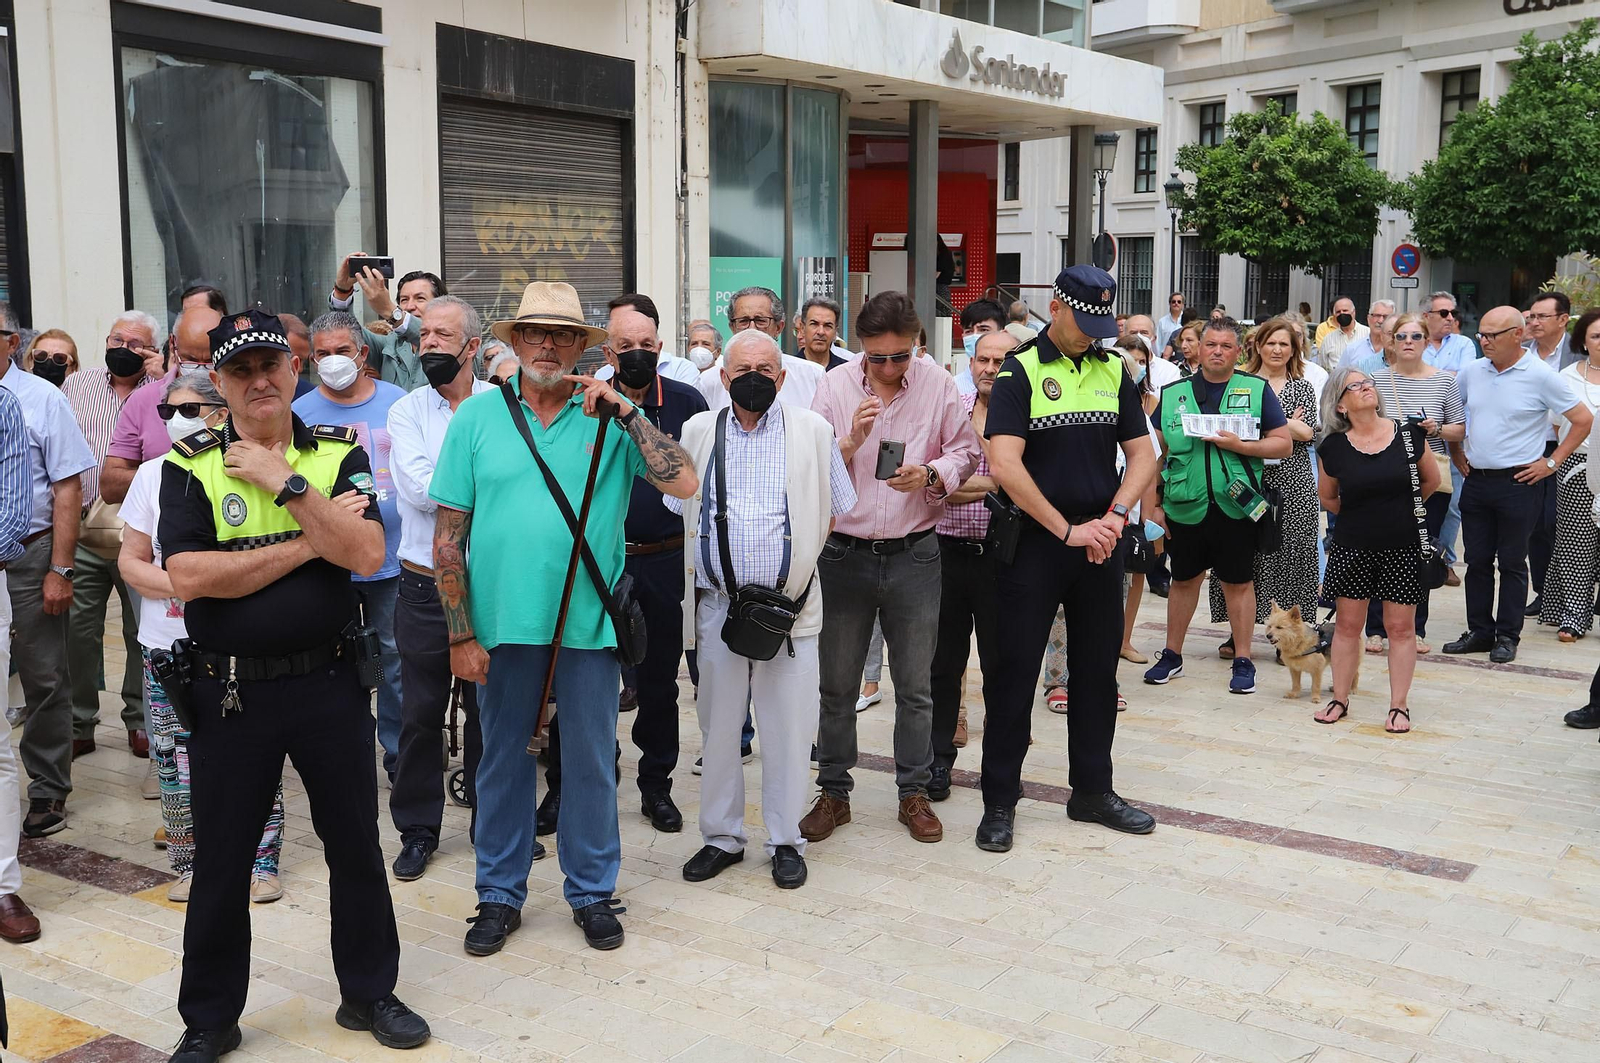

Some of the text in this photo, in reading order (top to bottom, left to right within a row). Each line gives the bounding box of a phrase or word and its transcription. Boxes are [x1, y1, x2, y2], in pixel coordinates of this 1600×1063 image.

[970, 45, 1068, 99] Santander
[1401, 430, 1415, 459] BIMBA
[1409, 463, 1421, 492] BIMBA
[1418, 528, 1431, 556] BIMBA
